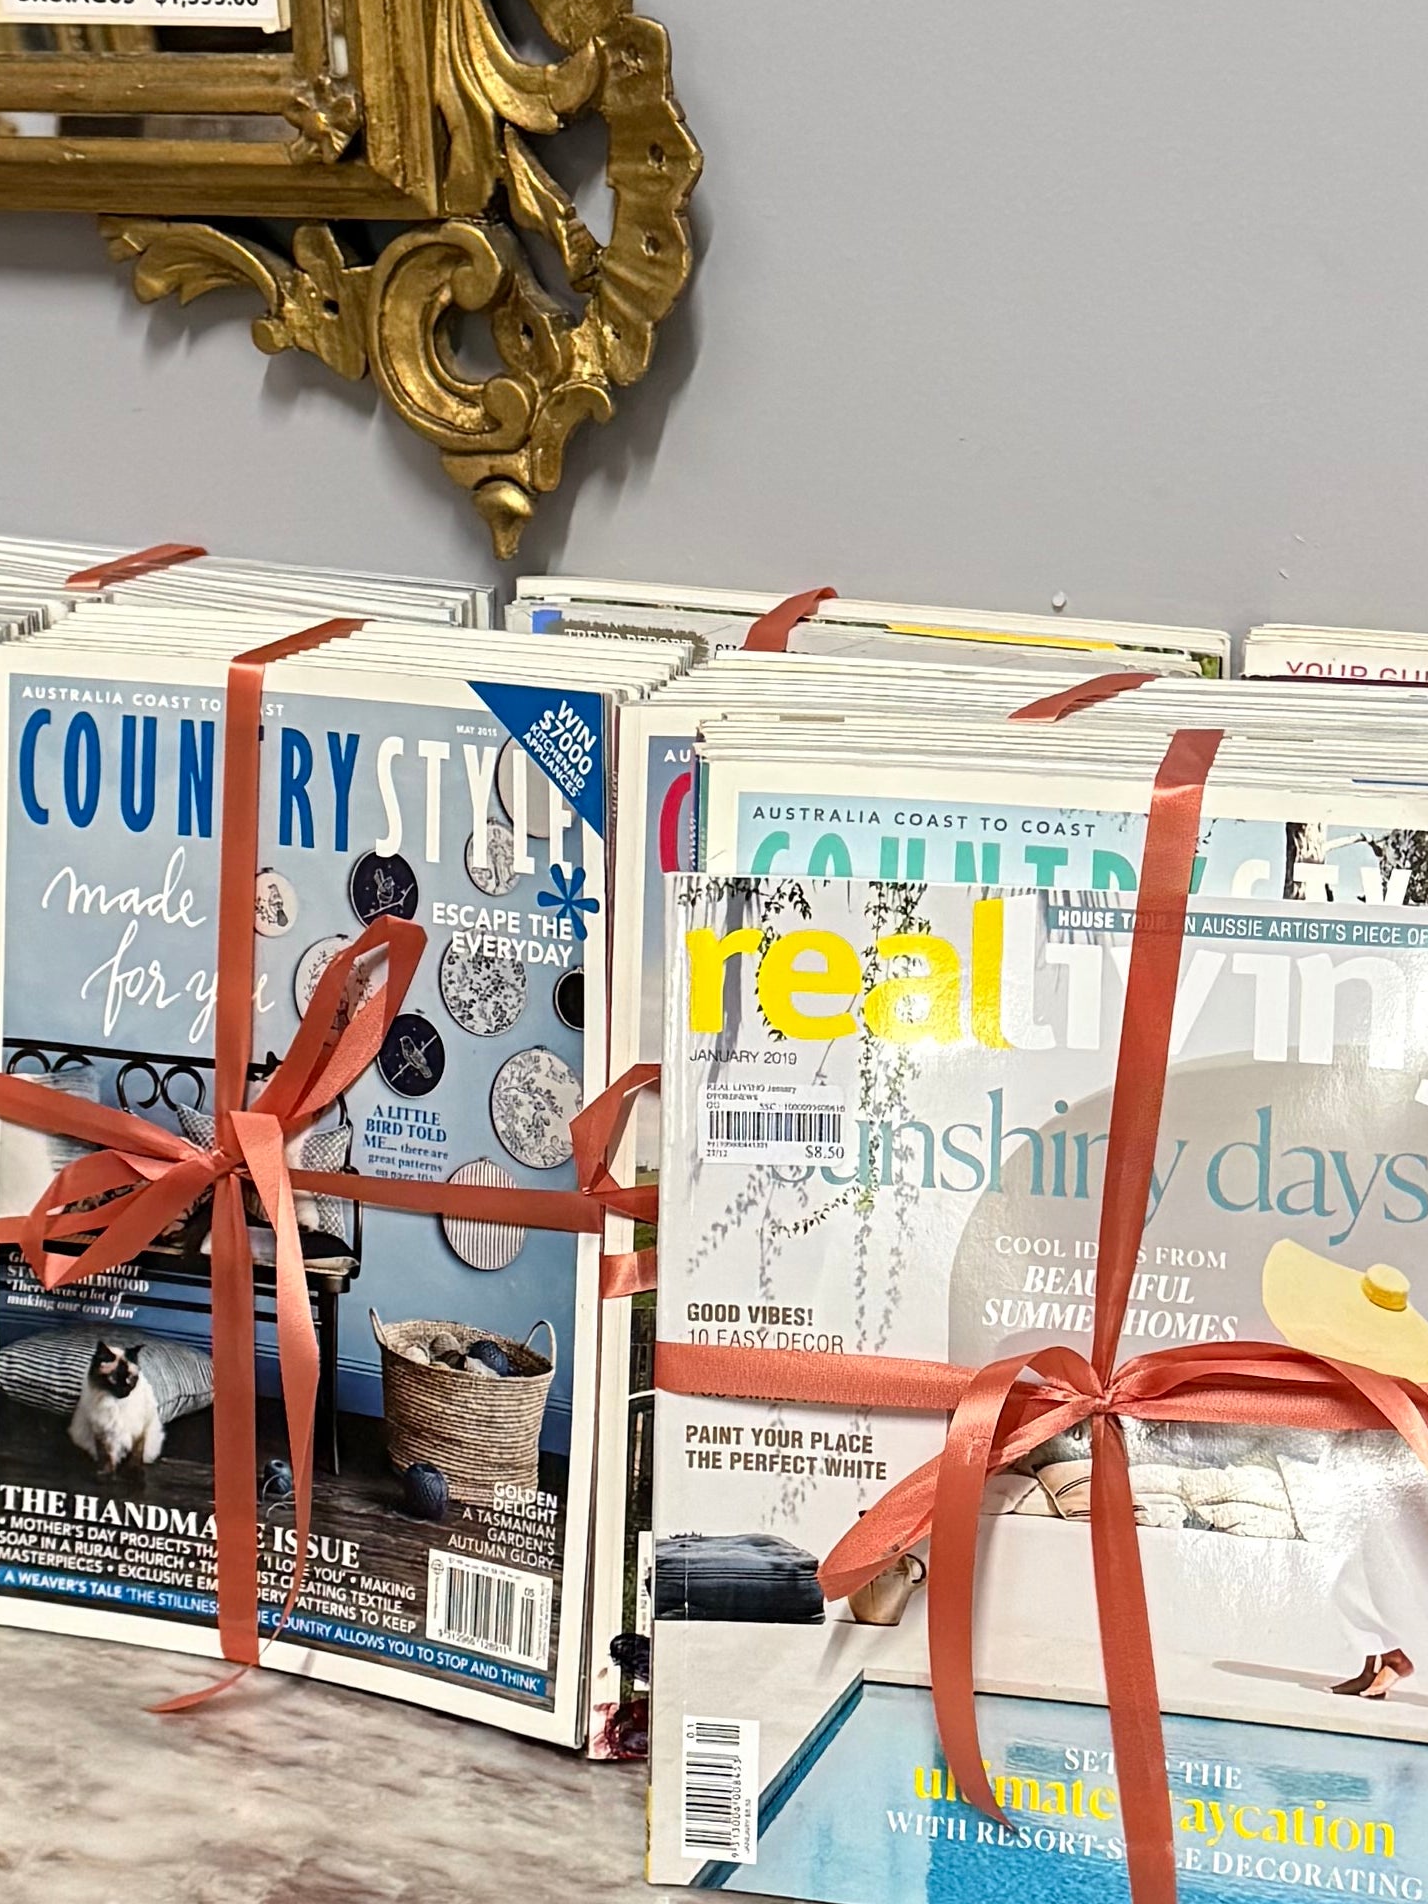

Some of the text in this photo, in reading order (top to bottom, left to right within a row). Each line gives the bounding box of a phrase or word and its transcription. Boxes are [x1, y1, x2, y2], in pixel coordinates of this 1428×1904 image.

[21, 685, 191, 713] AUSTRALIA COAST
[539, 710, 592, 776] $7000
[558, 699, 596, 752] WIN
[529, 722, 585, 790] KITCHENAID
[19, 709, 359, 854] COUNRY
[374, 735, 573, 880] STYLE
[752, 806, 1096, 838] AUSTRALIA COAST COAST
[42, 846, 207, 928] made
[432, 902, 573, 940] ESCAPE THE
[1058, 909, 1117, 929] HOUSE
[1202, 917, 1262, 937] AUSSIE
[1269, 923, 1346, 941] ARTIST'S
[1353, 926, 1402, 944] PIECE
[452, 930, 573, 969] EVERYDAY
[81, 919, 181, 1037] for
[685, 898, 1013, 1052] real
[690, 1050, 797, 1065] JANUARY 2019
[388, 1106, 440, 1126] LITTLE
[368, 1154, 443, 1172] great patterns
[401, 1144, 427, 1157] there
[805, 1146, 844, 1159] $8.50
[995, 1235, 1227, 1270] COOL FROM
[687, 1303, 813, 1327] GOOD VIBES!
[777, 1332, 844, 1354] DECOR
[685, 1426, 872, 1454] PAINT YOUR PLACE
[685, 1451, 887, 1480] THE PERFECT WHITE
[493, 1481, 558, 1508] GOLDEN
[493, 1500, 558, 1524] DELIGHT
[0, 1485, 265, 1549] THE HANDMAE
[477, 1510, 556, 1540] TASMANIAN
[10, 1516, 415, 1600] MOTHER'S PROJECTS MAKING
[448, 1534, 555, 1570] AUTUMN GLORY
[487, 1528, 555, 1555] GARDEN'S
[75, 1541, 121, 1560] RURAL
[125, 1548, 184, 1569] CHURCH
[351, 1589, 402, 1613] TEXTILE
[118, 1564, 193, 1587] EXCLUSIVE
[18, 1573, 385, 1649] WEAVER'S ALLOWS
[1212, 1851, 1423, 1901] DECORATING
